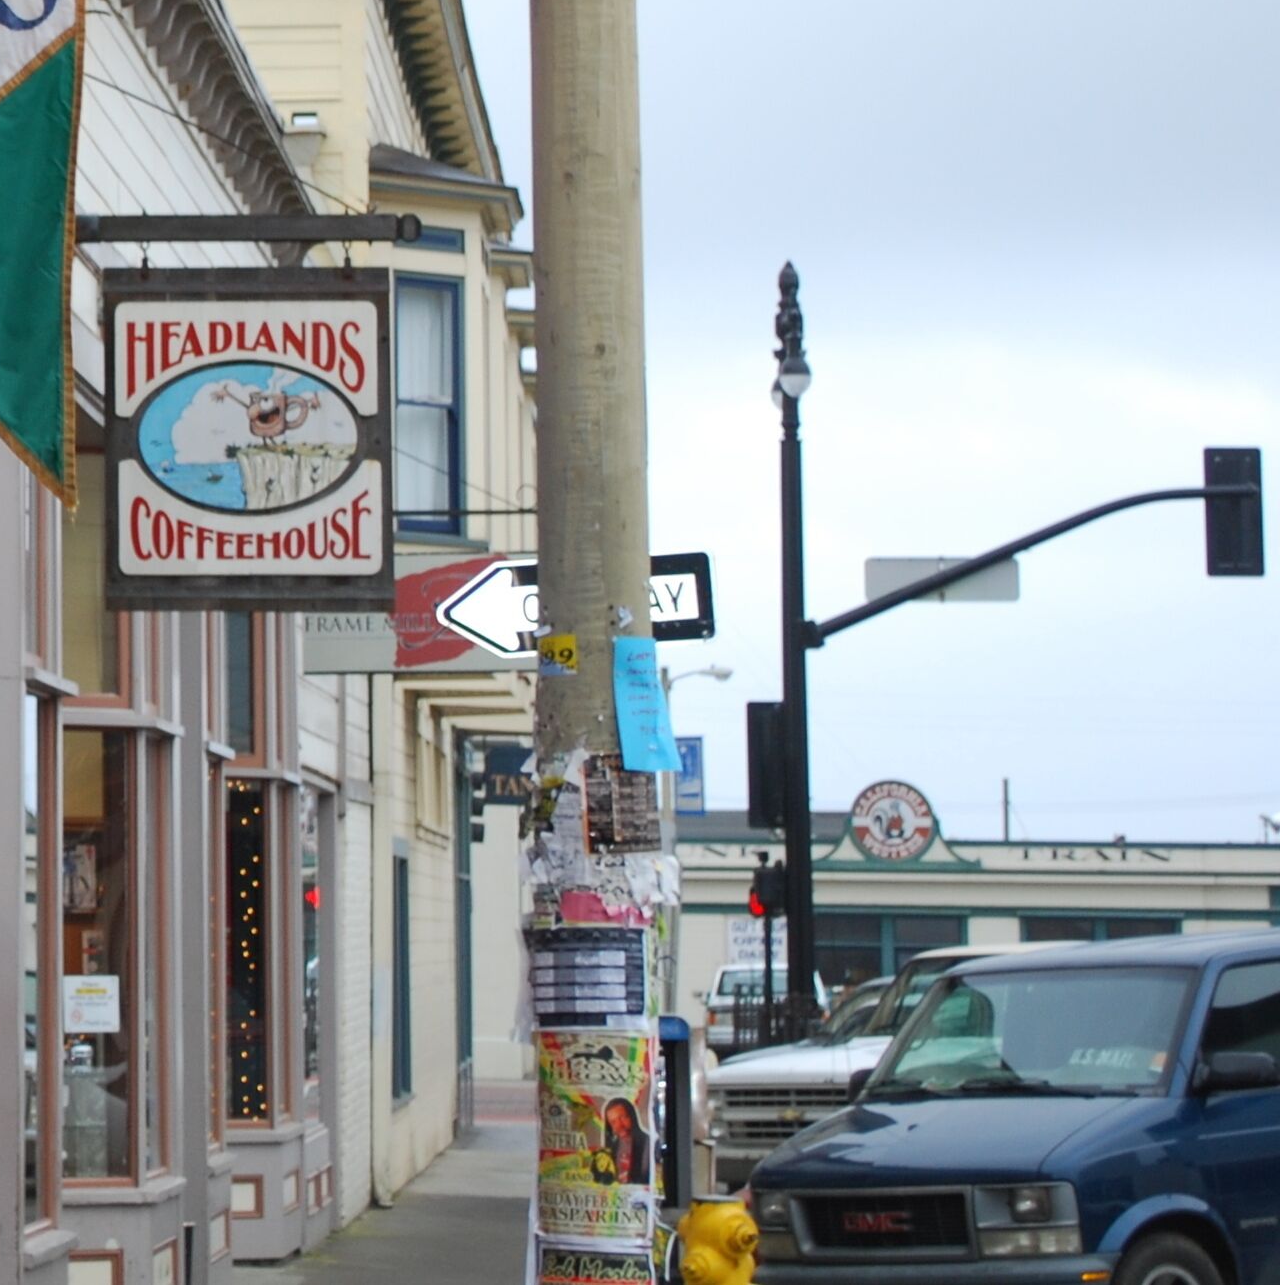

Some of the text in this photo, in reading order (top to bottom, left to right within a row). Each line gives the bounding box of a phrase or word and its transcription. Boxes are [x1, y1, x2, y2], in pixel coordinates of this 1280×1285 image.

[126, 320, 365, 401] HEADLANDS
[130, 490, 372, 562] COFFEEHOUSE
[304, 615, 375, 633] FRAME
[1010, 847, 1174, 863] TRAIN
[843, 1211, 912, 1232] GMC
